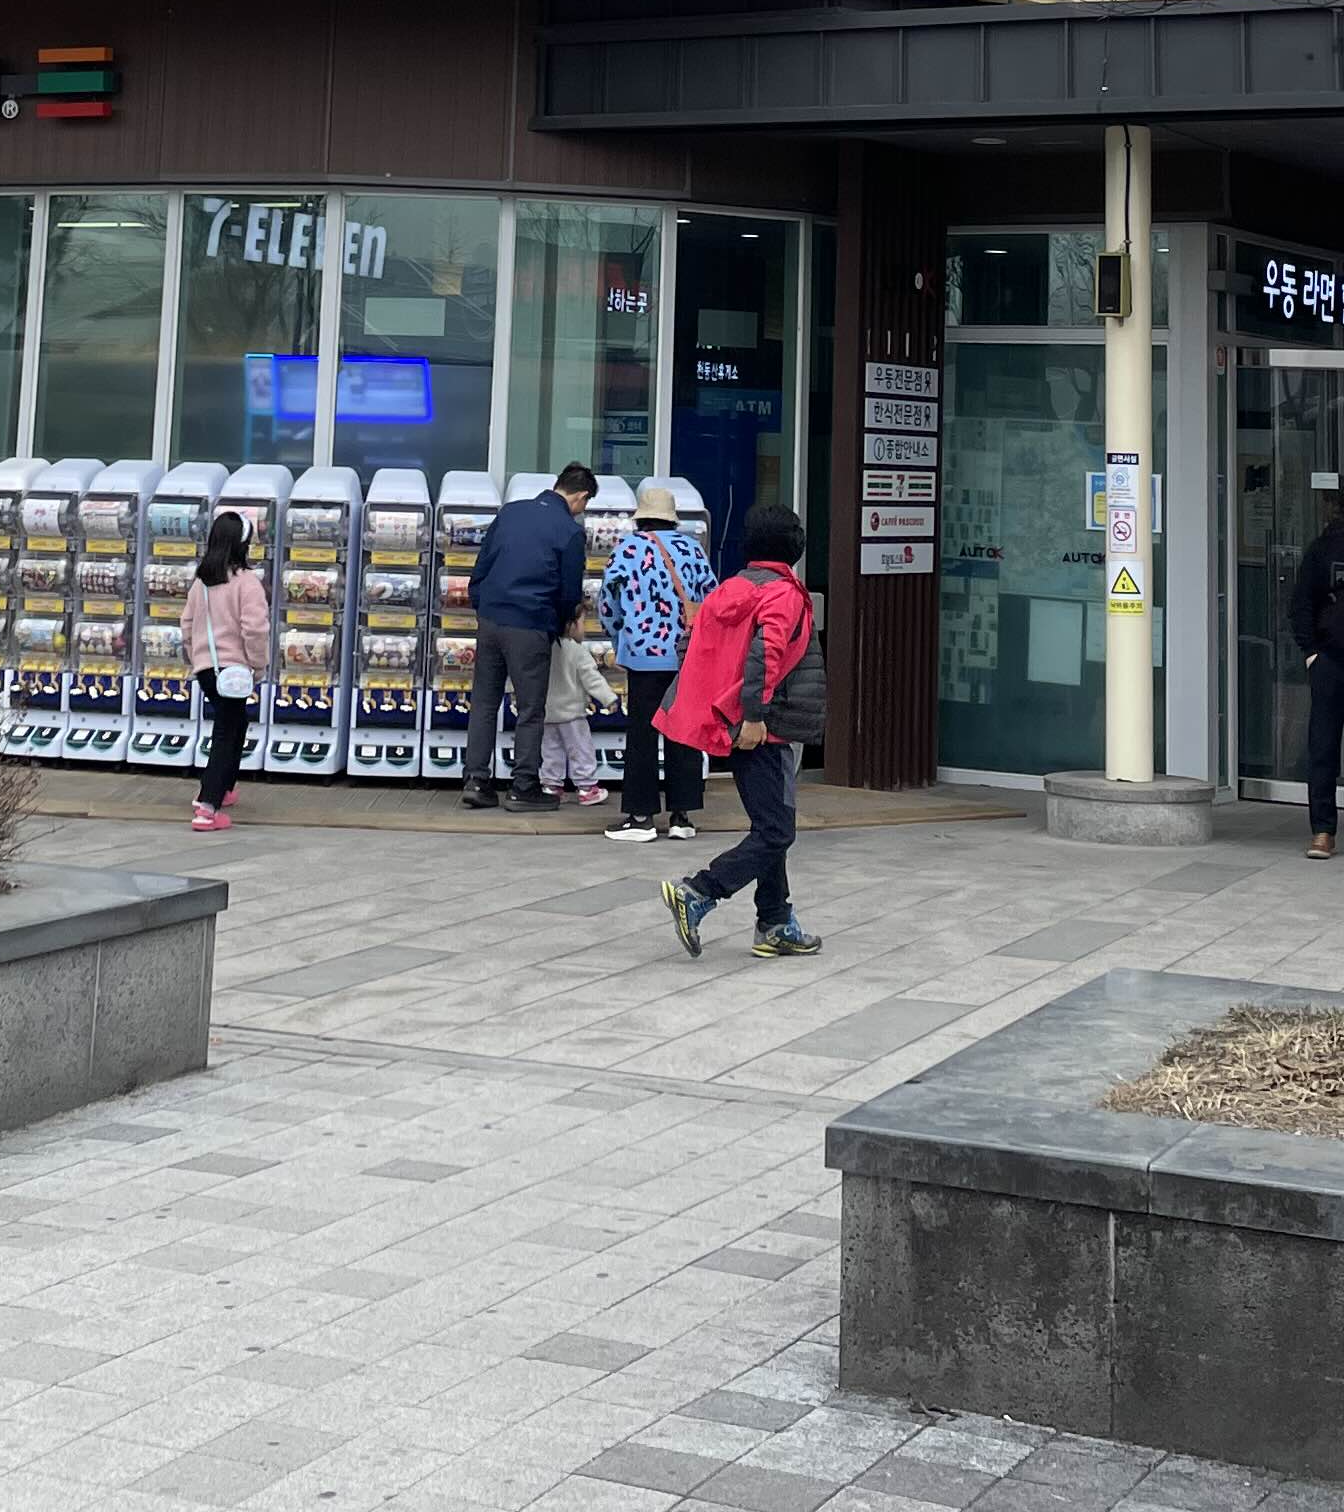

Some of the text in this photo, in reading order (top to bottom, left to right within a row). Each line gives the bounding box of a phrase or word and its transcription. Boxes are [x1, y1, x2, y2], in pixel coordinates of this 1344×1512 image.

[1263, 259, 1298, 319] 우동
[1303, 270, 1336, 324] 라면
[874, 366, 923, 393] 우동전문점
[735, 399, 772, 416] ATM
[874, 401, 922, 427] 한식전문점
[886, 439, 930, 461] 종합안내소
